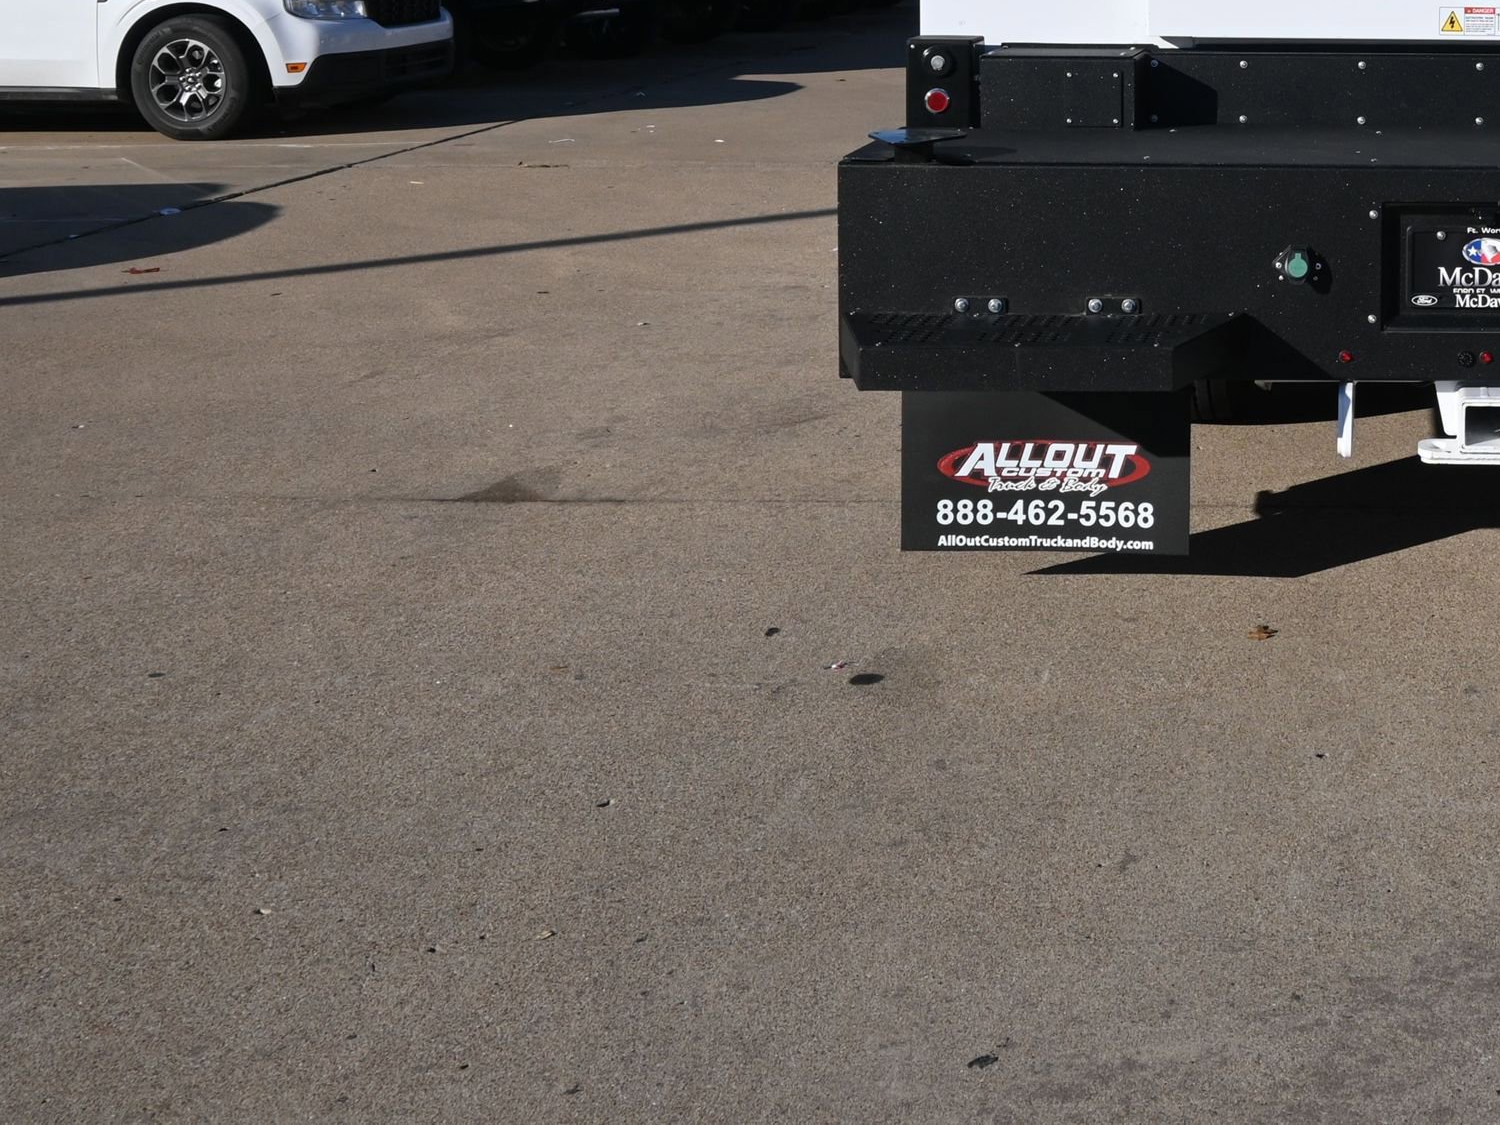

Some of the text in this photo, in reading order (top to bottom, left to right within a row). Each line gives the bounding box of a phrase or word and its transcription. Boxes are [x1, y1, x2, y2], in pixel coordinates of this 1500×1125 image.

[954, 442, 1138, 479] ALLOUT
[1001, 467, 1105, 478] CUSTOM
[987, 476, 1108, 497] Truck & Body
[936, 499, 1155, 529] 888-462-5568
[937, 535, 1154, 551] AllOutCustomTruckandBody.com
